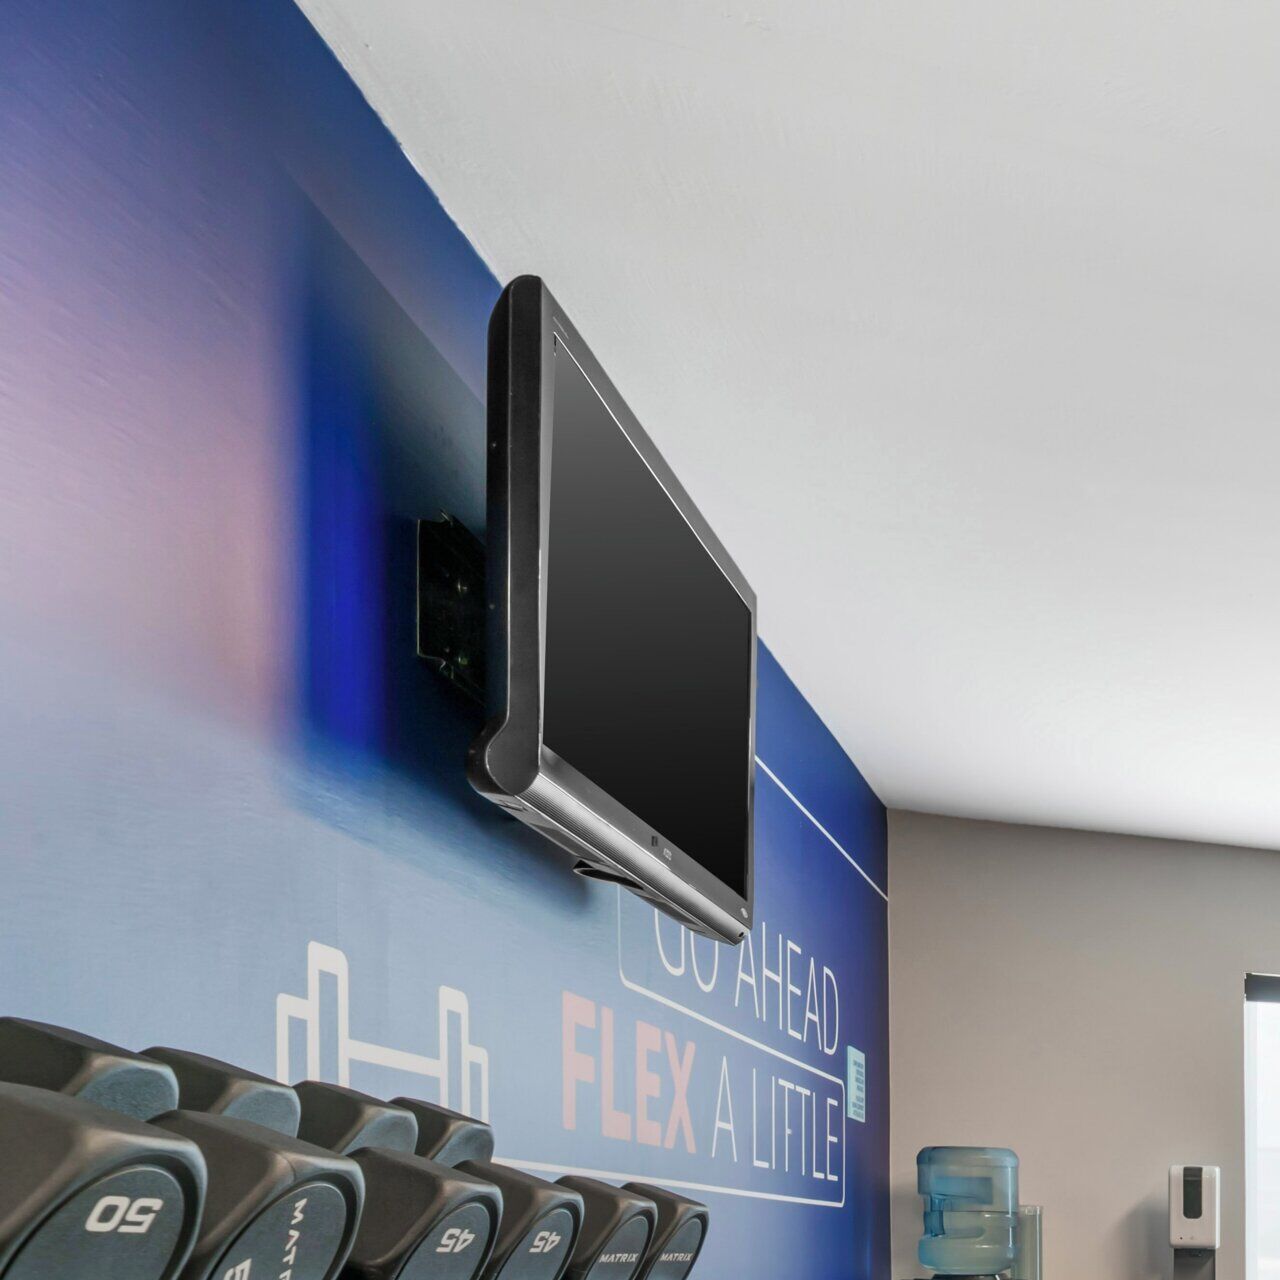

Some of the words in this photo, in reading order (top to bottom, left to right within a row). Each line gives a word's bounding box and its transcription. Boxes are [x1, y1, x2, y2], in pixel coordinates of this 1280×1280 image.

[735, 921, 839, 1055] AHEAD
[561, 989, 697, 1154] FLEX
[711, 1055, 738, 1162] A
[85, 1195, 164, 1234] 50
[436, 1228, 477, 1253] 45
[529, 1231, 561, 1253] 45
[599, 1252, 638, 1264] MATRIX
[659, 1252, 694, 1263] MATRIX
